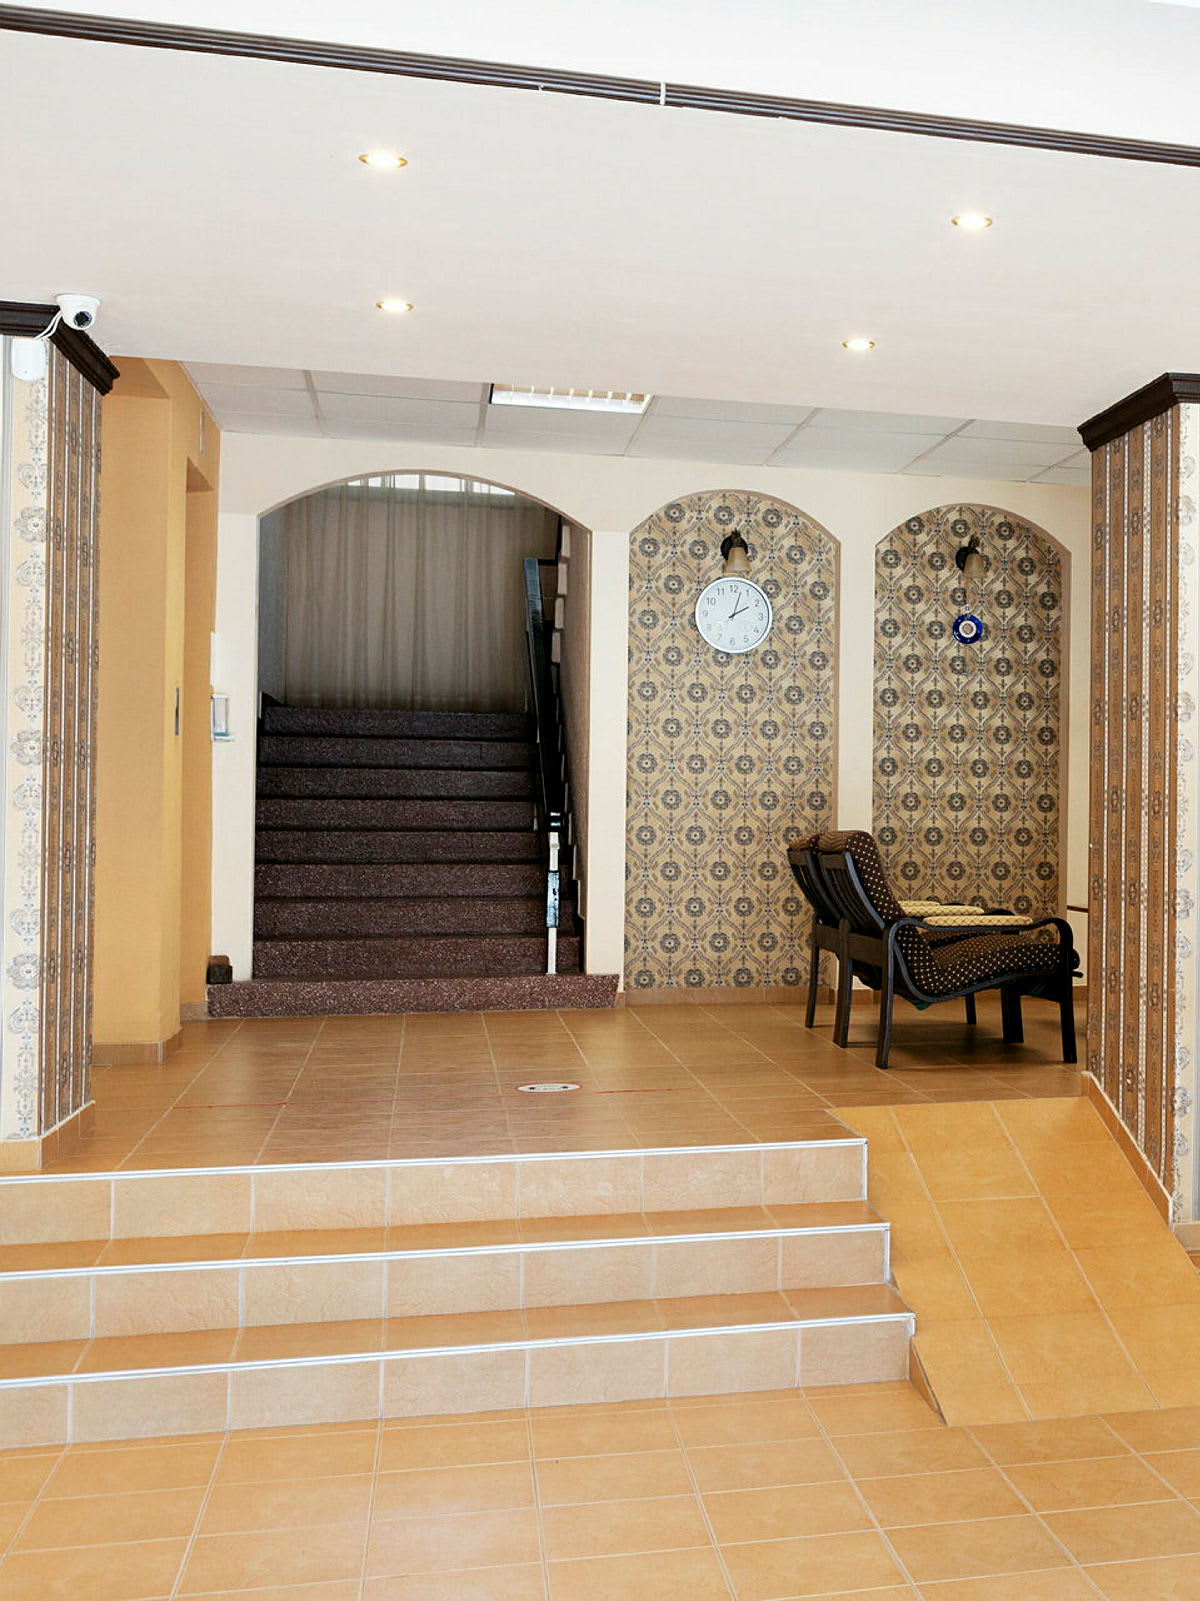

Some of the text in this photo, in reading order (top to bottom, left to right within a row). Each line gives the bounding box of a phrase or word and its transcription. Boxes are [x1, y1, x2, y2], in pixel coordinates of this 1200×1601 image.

[717, 588, 725, 596] 11
[729, 585, 739, 593] 12
[707, 597, 716, 606] 10
[754, 599, 760, 607] 2
[758, 612, 764, 621] 3
[753, 626, 759, 634] 4
[730, 638, 735, 646] 6
[743, 634, 749, 643] 5
